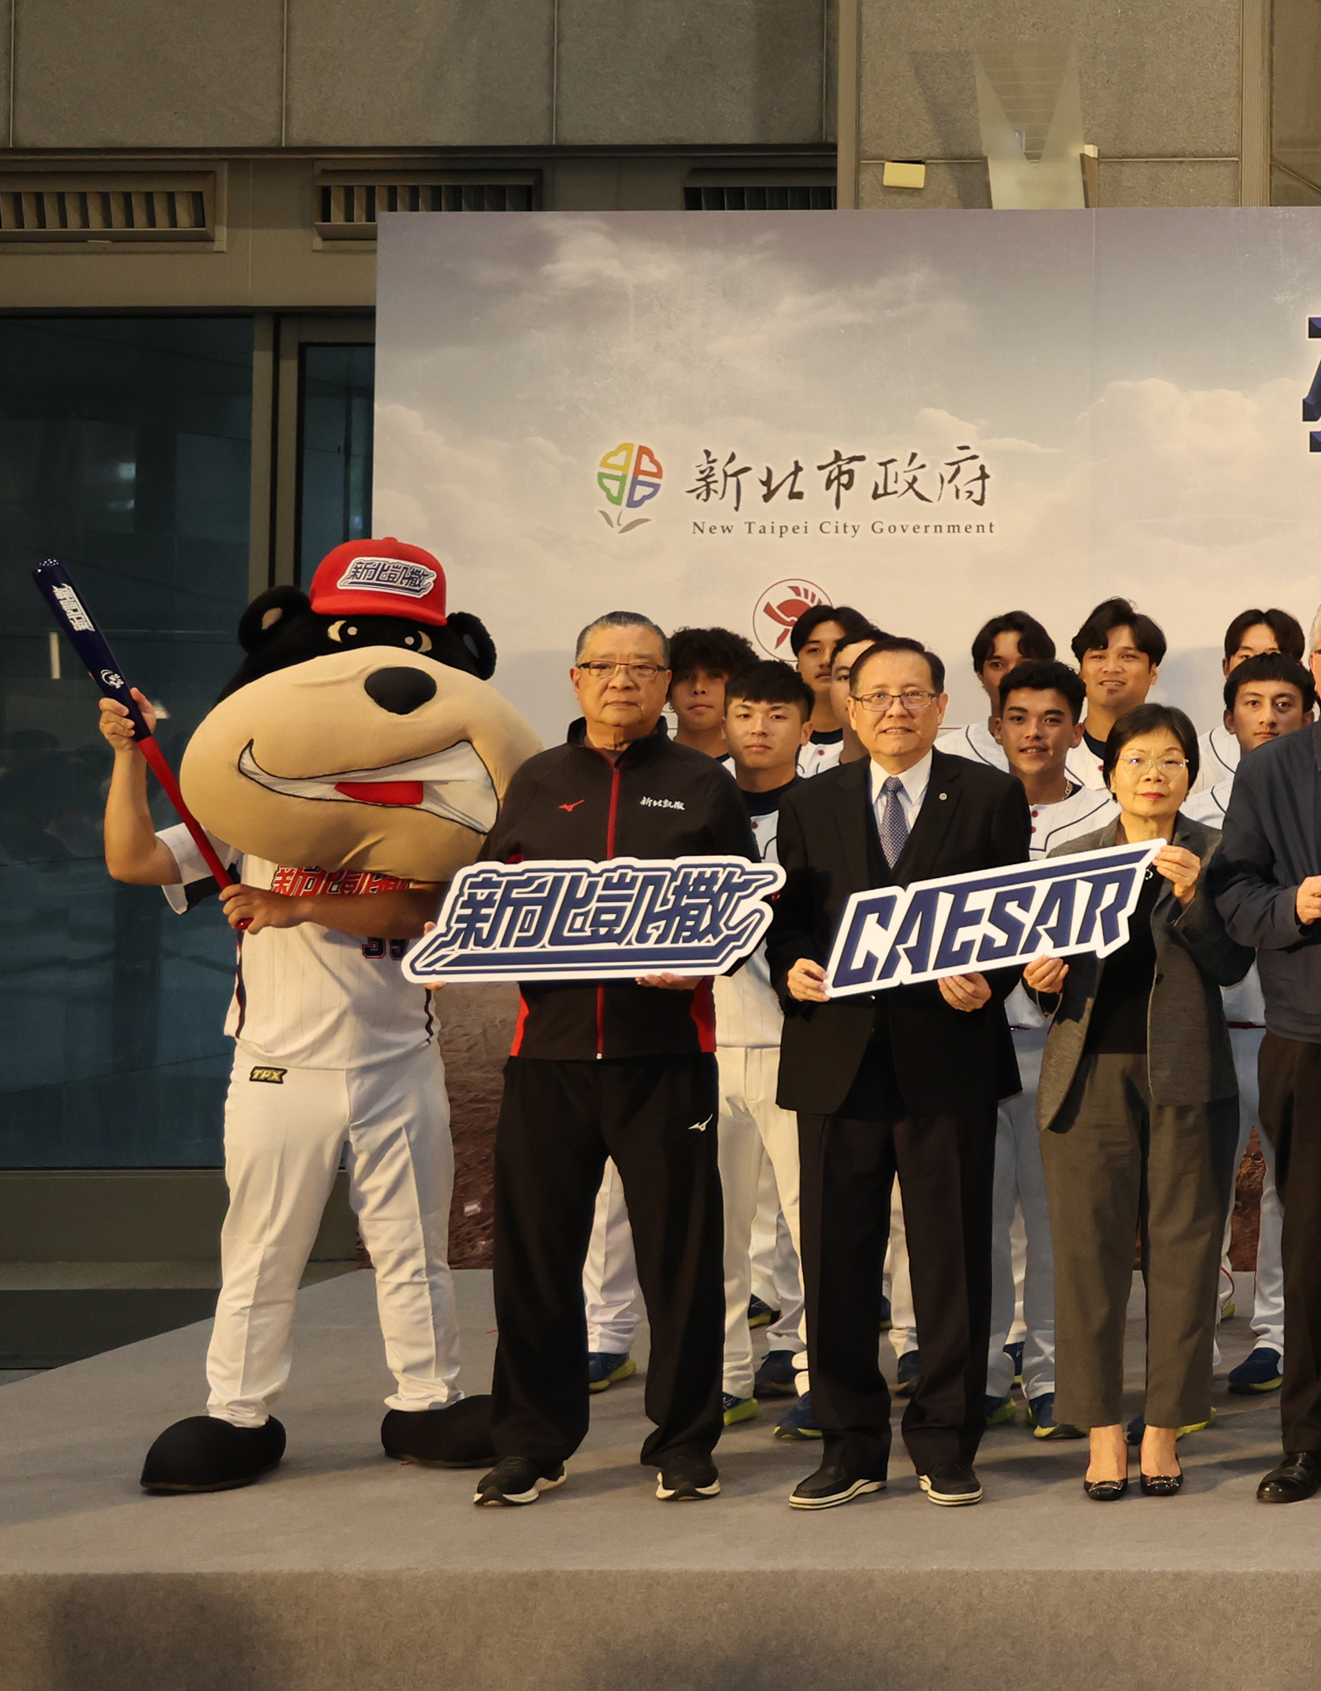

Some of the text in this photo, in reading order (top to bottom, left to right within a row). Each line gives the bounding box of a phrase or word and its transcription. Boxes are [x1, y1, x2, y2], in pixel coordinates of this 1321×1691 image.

[685, 446, 991, 512] 新北市政府
[692, 520, 996, 538] New Taipei City Government
[345, 560, 435, 590] 新北凱撒
[440, 866, 776, 952] 新北凱撒
[832, 849, 1151, 988] CAESAR
[251, 1067, 285, 1083] TPX
